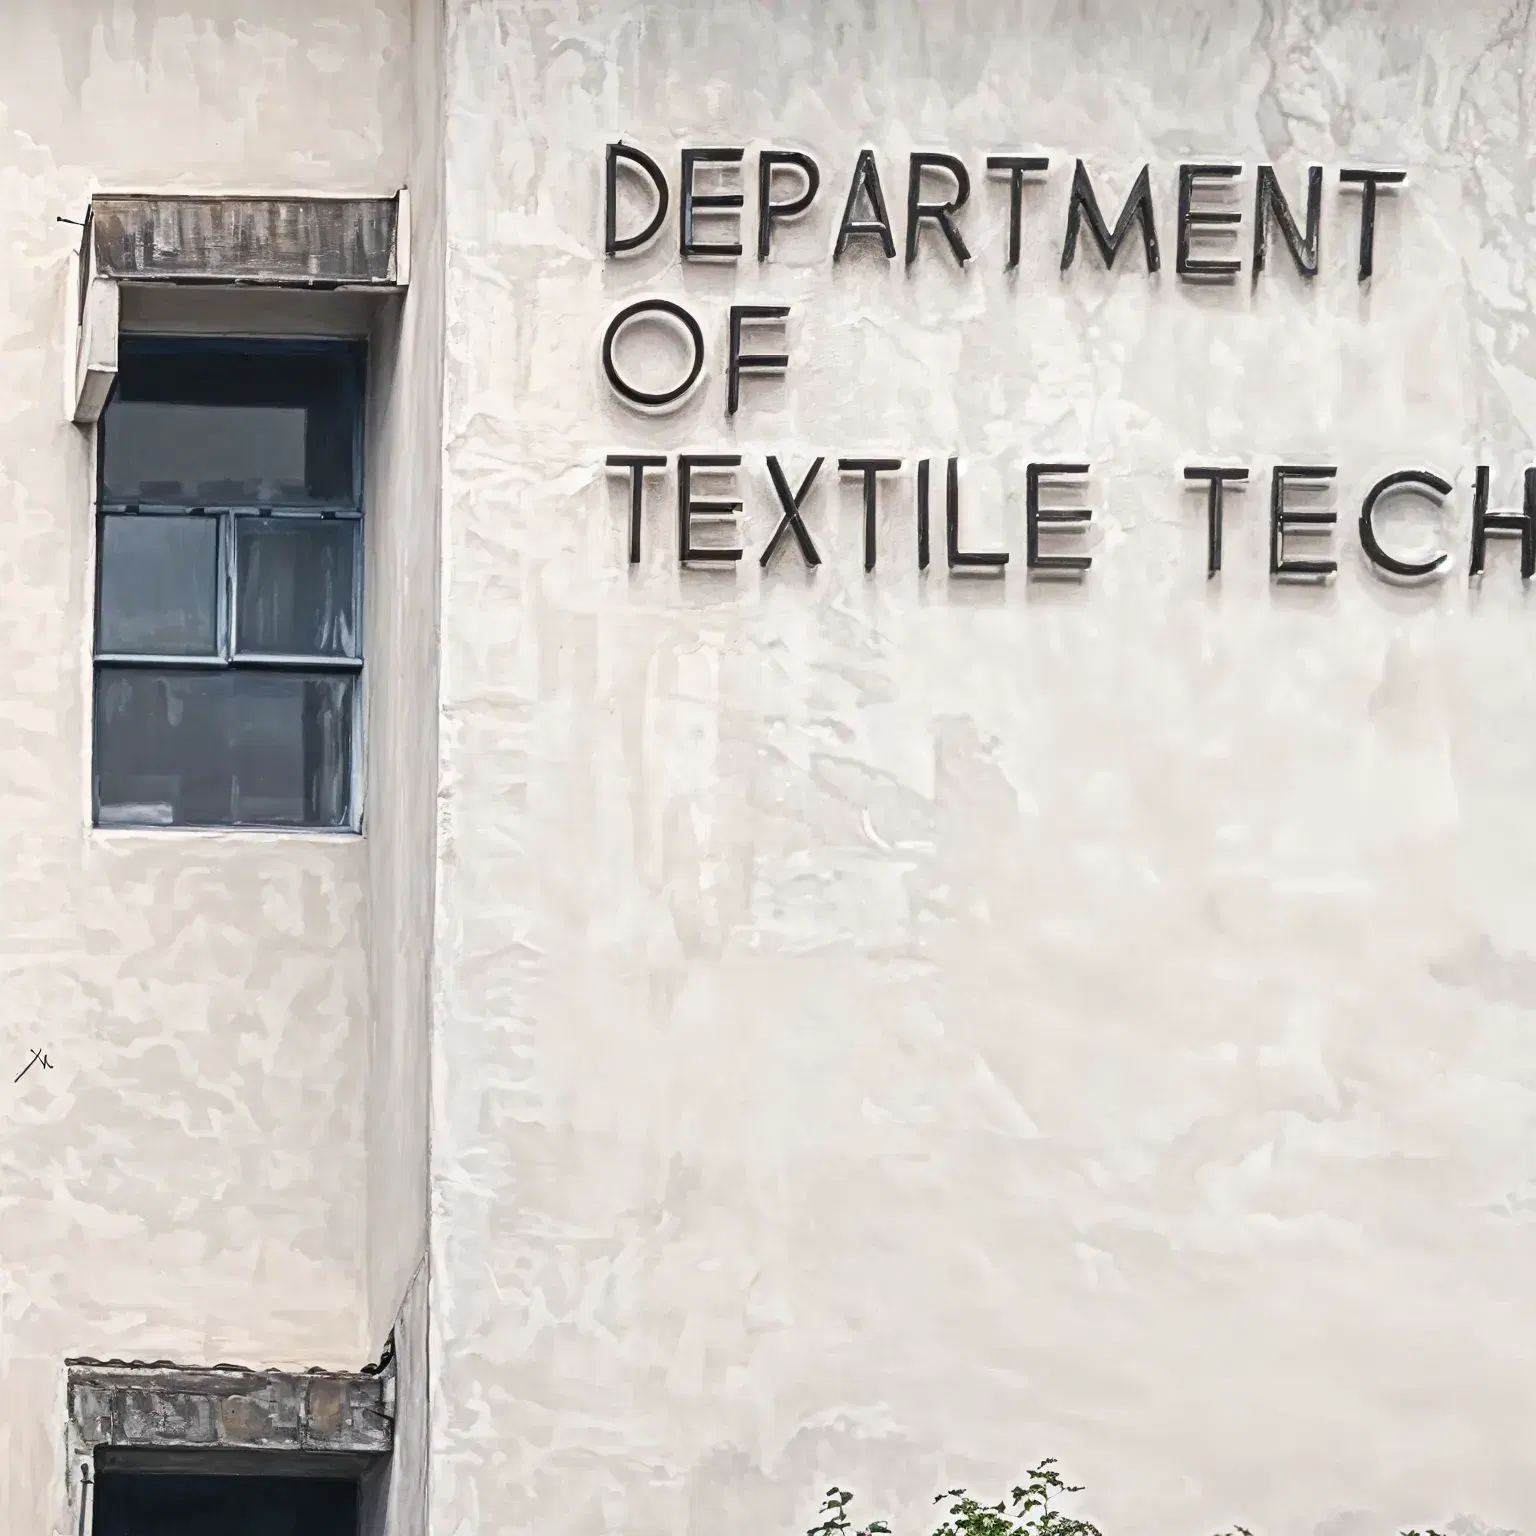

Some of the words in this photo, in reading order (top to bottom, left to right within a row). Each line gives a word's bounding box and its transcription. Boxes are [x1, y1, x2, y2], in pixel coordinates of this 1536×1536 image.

[605, 142, 1407, 281] DEPARTMENT
[602, 298, 791, 415] OF
[606, 454, 1093, 572] TEXTILE
